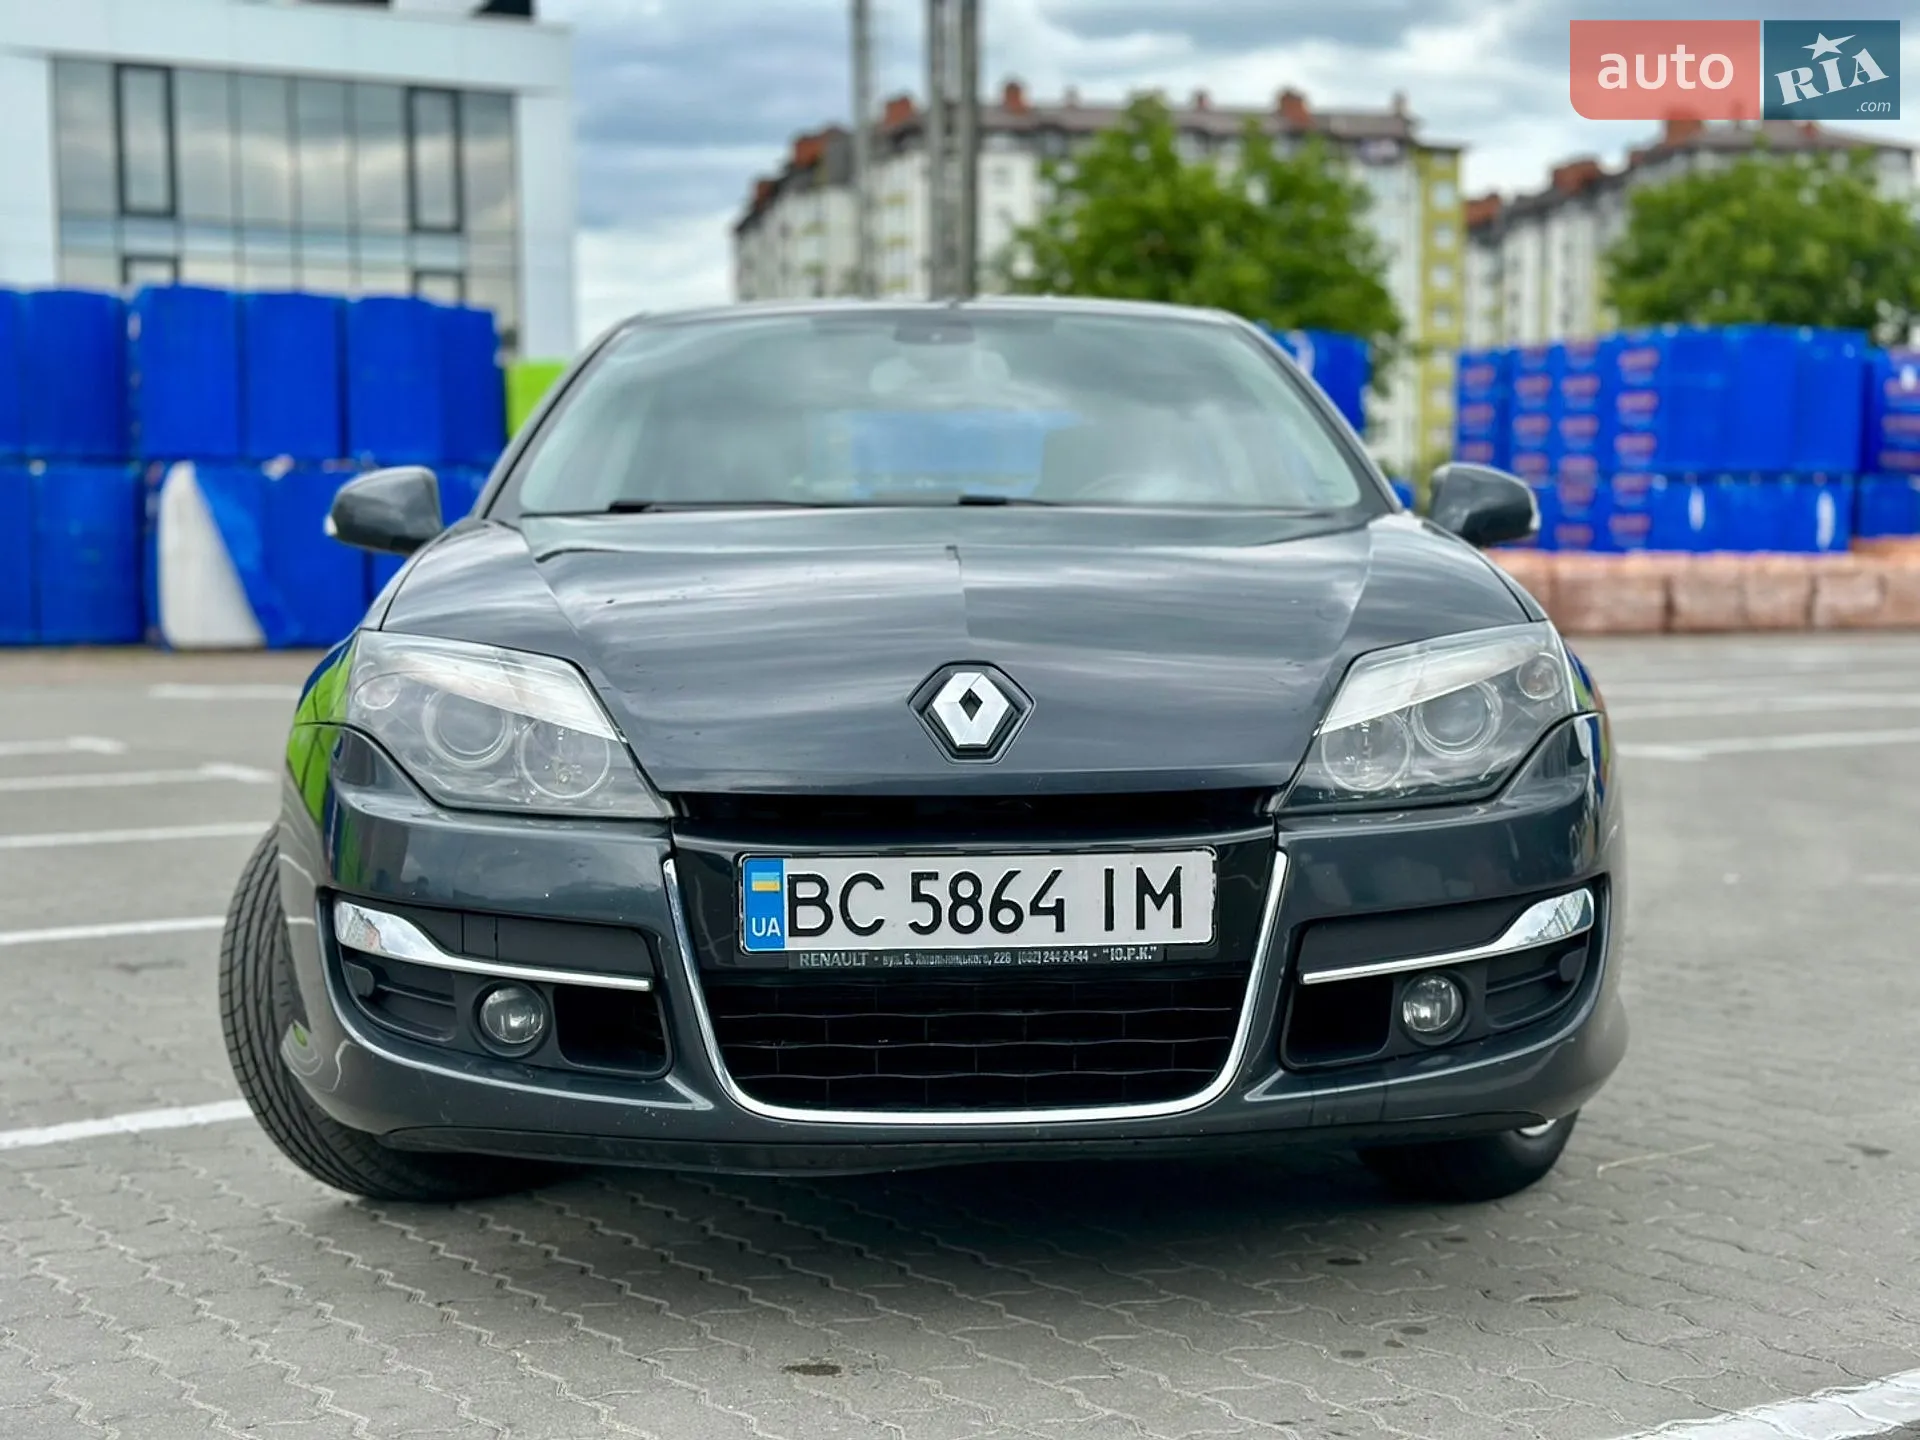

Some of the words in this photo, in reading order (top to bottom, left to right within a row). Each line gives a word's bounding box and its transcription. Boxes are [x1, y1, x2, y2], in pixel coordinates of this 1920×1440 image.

[787, 872, 885, 937] BC
[908, 869, 1065, 935] 5864
[1104, 866, 1182, 932] IM
[751, 916, 781, 937] UA
[799, 952, 869, 967] RENAULT
